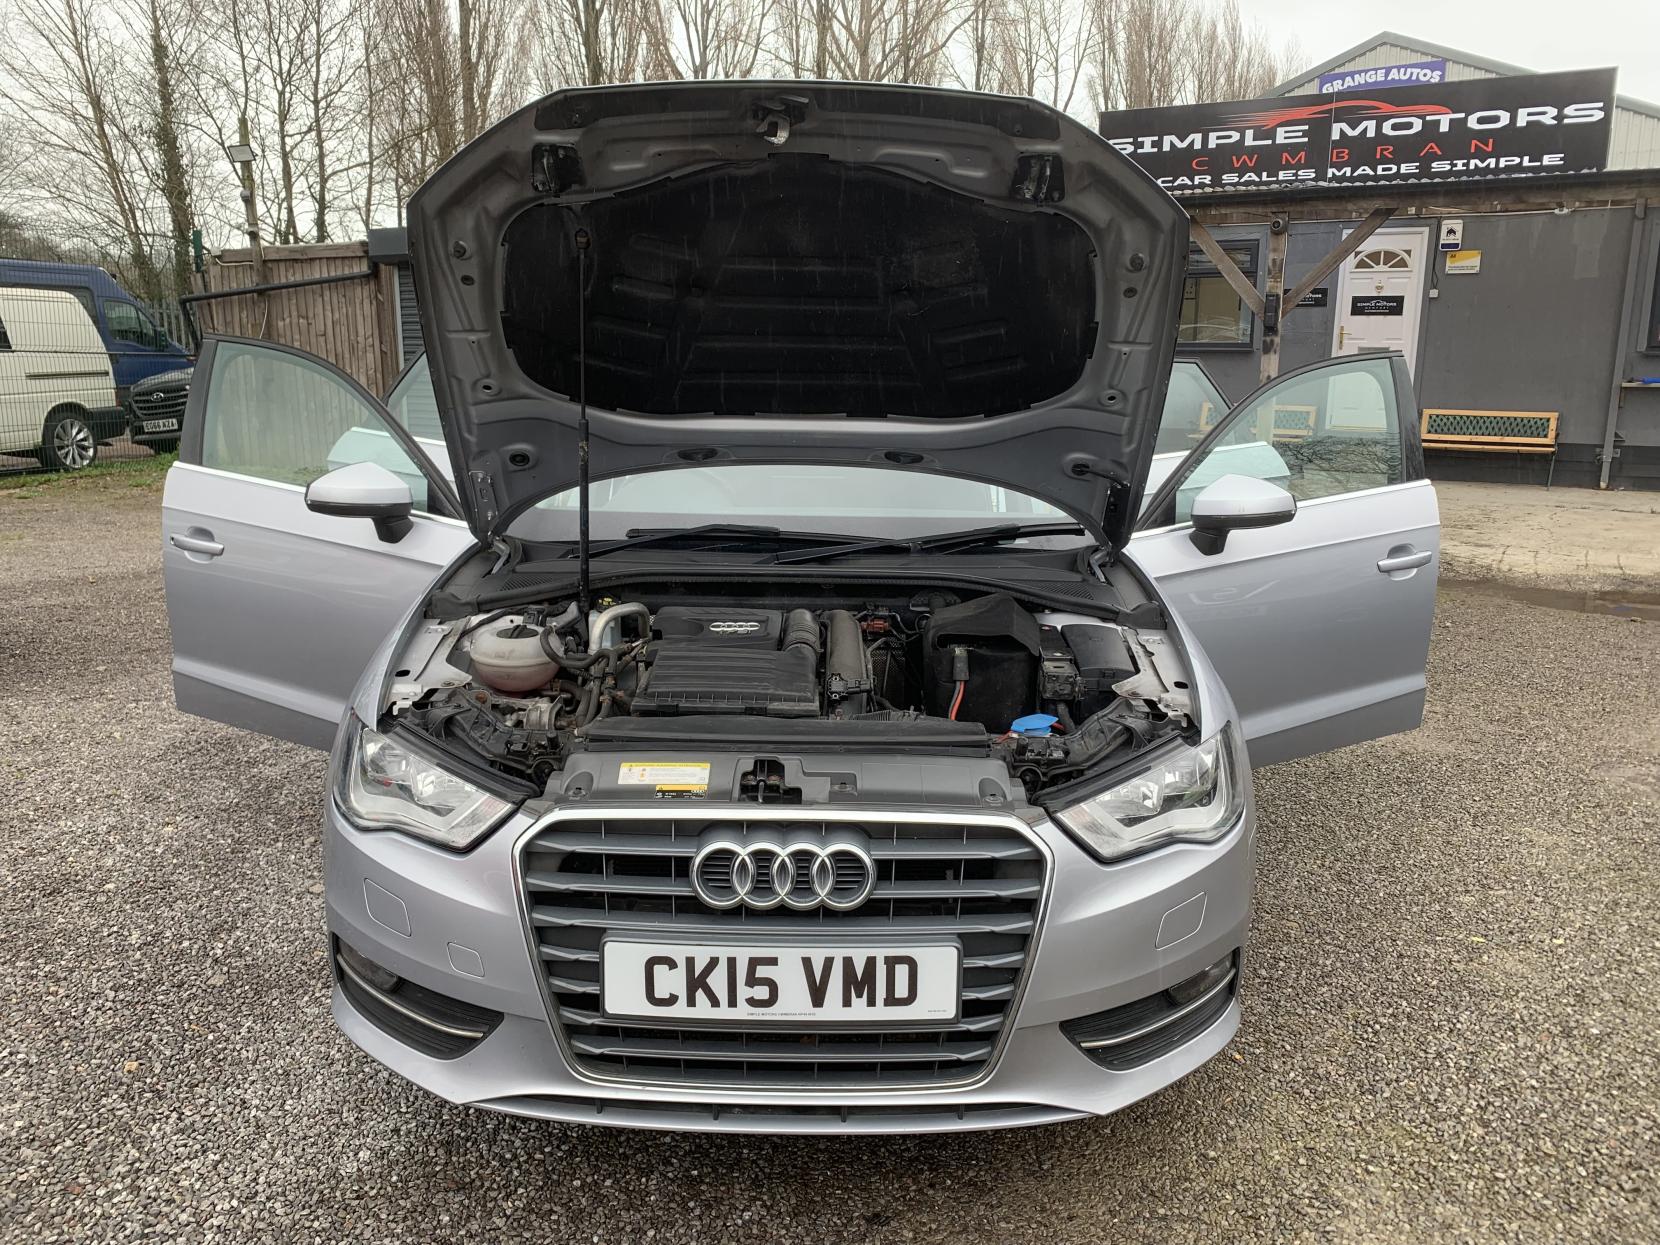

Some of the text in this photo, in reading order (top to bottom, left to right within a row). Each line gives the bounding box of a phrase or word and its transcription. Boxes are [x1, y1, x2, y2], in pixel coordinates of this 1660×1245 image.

[1322, 67, 1443, 94] GRANGE AUTOS
[1109, 102, 1606, 154] SIMPLE MOTORS
[1157, 153, 1565, 188] CAR SALES MADE SIMPLE
[644, 955, 919, 1009] CK15 VMD
